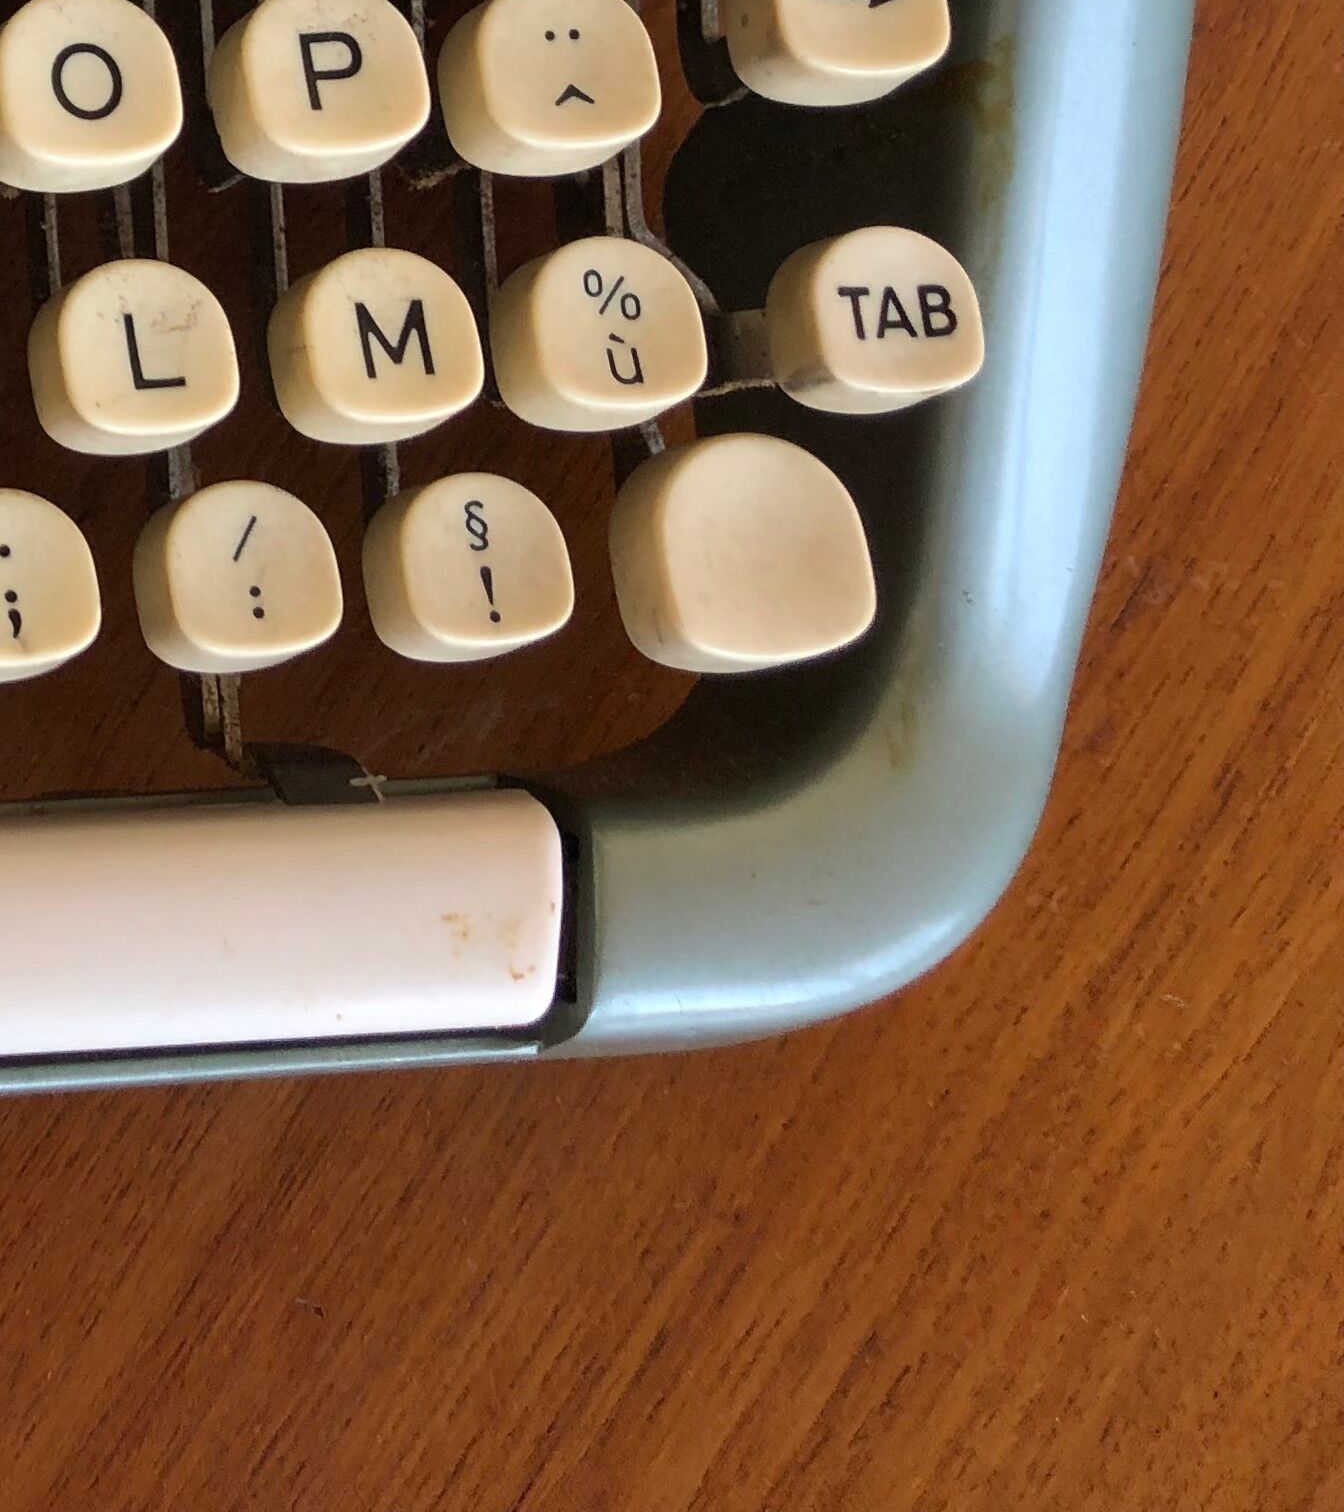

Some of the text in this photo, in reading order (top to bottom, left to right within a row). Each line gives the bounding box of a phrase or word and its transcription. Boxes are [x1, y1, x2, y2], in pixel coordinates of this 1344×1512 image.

[51, 42, 123, 121] O
[298, 31, 363, 111] P
[354, 299, 436, 379] M
[837, 284, 958, 341] TAB
[123, 313, 187, 391] L
[606, 333, 644, 385] ù
